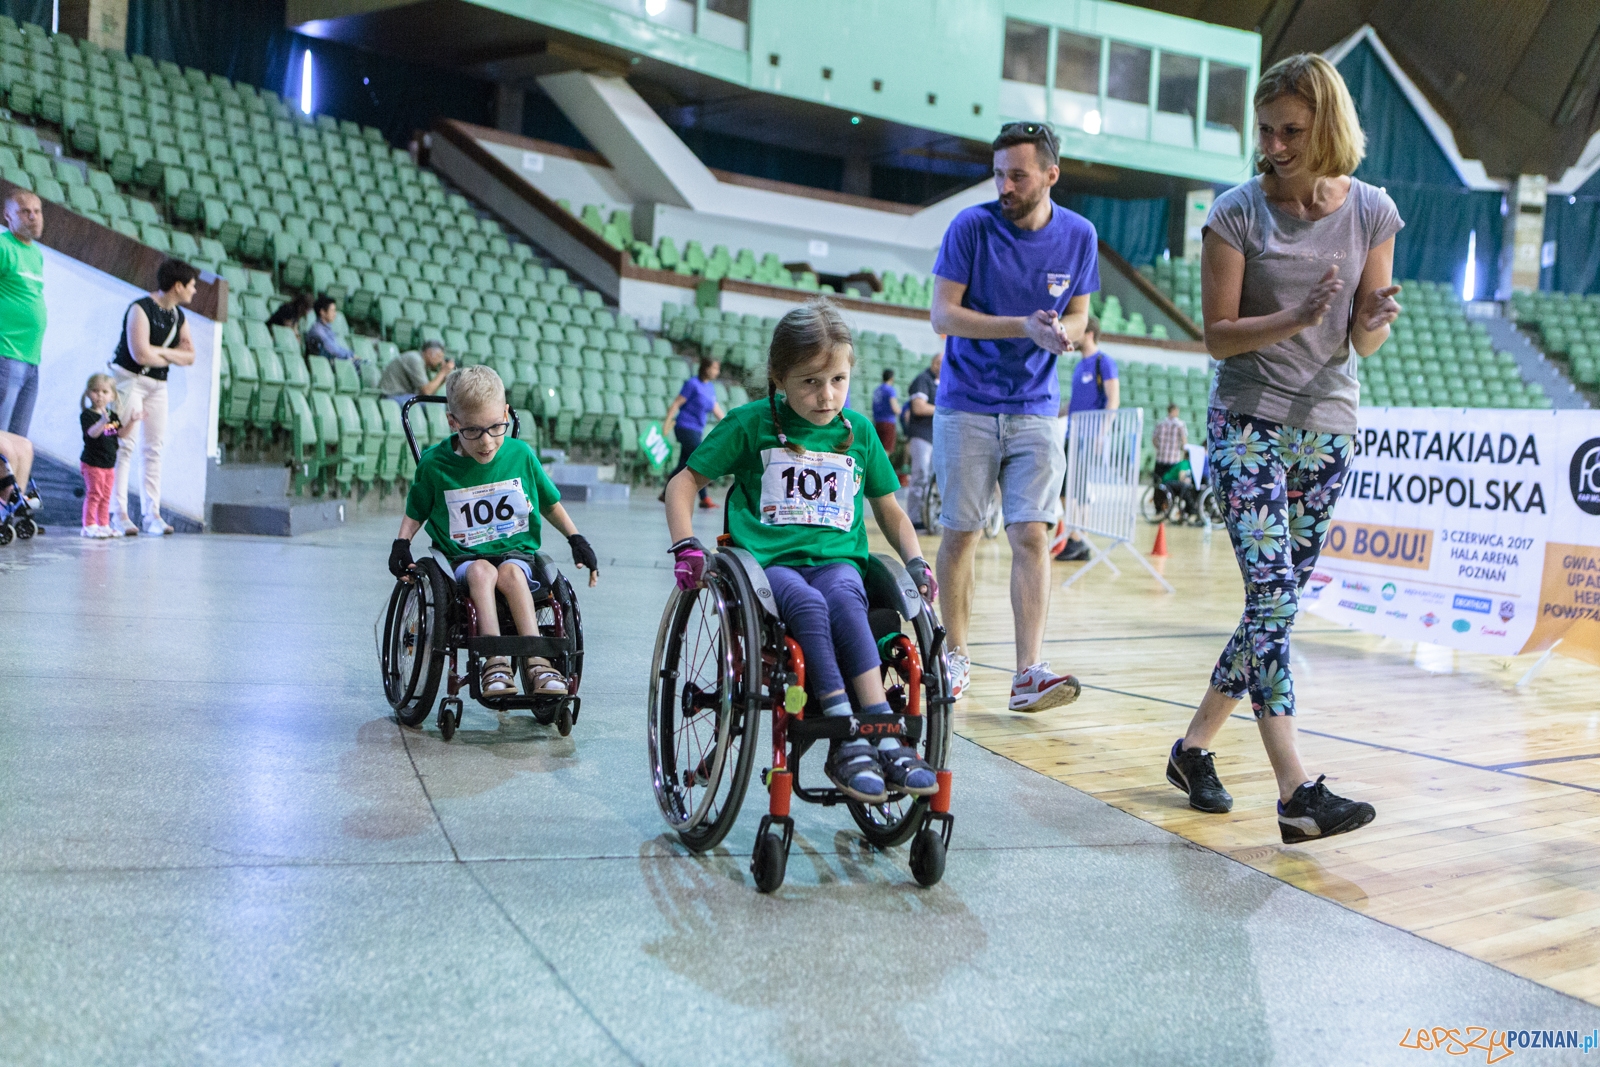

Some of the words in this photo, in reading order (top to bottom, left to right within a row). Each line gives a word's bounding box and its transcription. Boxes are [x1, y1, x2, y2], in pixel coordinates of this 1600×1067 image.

[781, 466, 837, 503] 101
[1341, 470, 1547, 514] IELKOPOLSKA
[460, 495, 514, 528] 106
[1352, 527, 1427, 564] BOJU!
[1441, 529, 1448, 542] 3
[1450, 530, 1504, 547] CZERWCA
[1507, 536, 1534, 551] 2017
[1450, 547, 1478, 561] HALA
[1481, 550, 1519, 567] ARENA
[1562, 554, 1600, 571] GWIA
[1458, 564, 1507, 582] POZNAŃ
[859, 722, 901, 735] GTM
